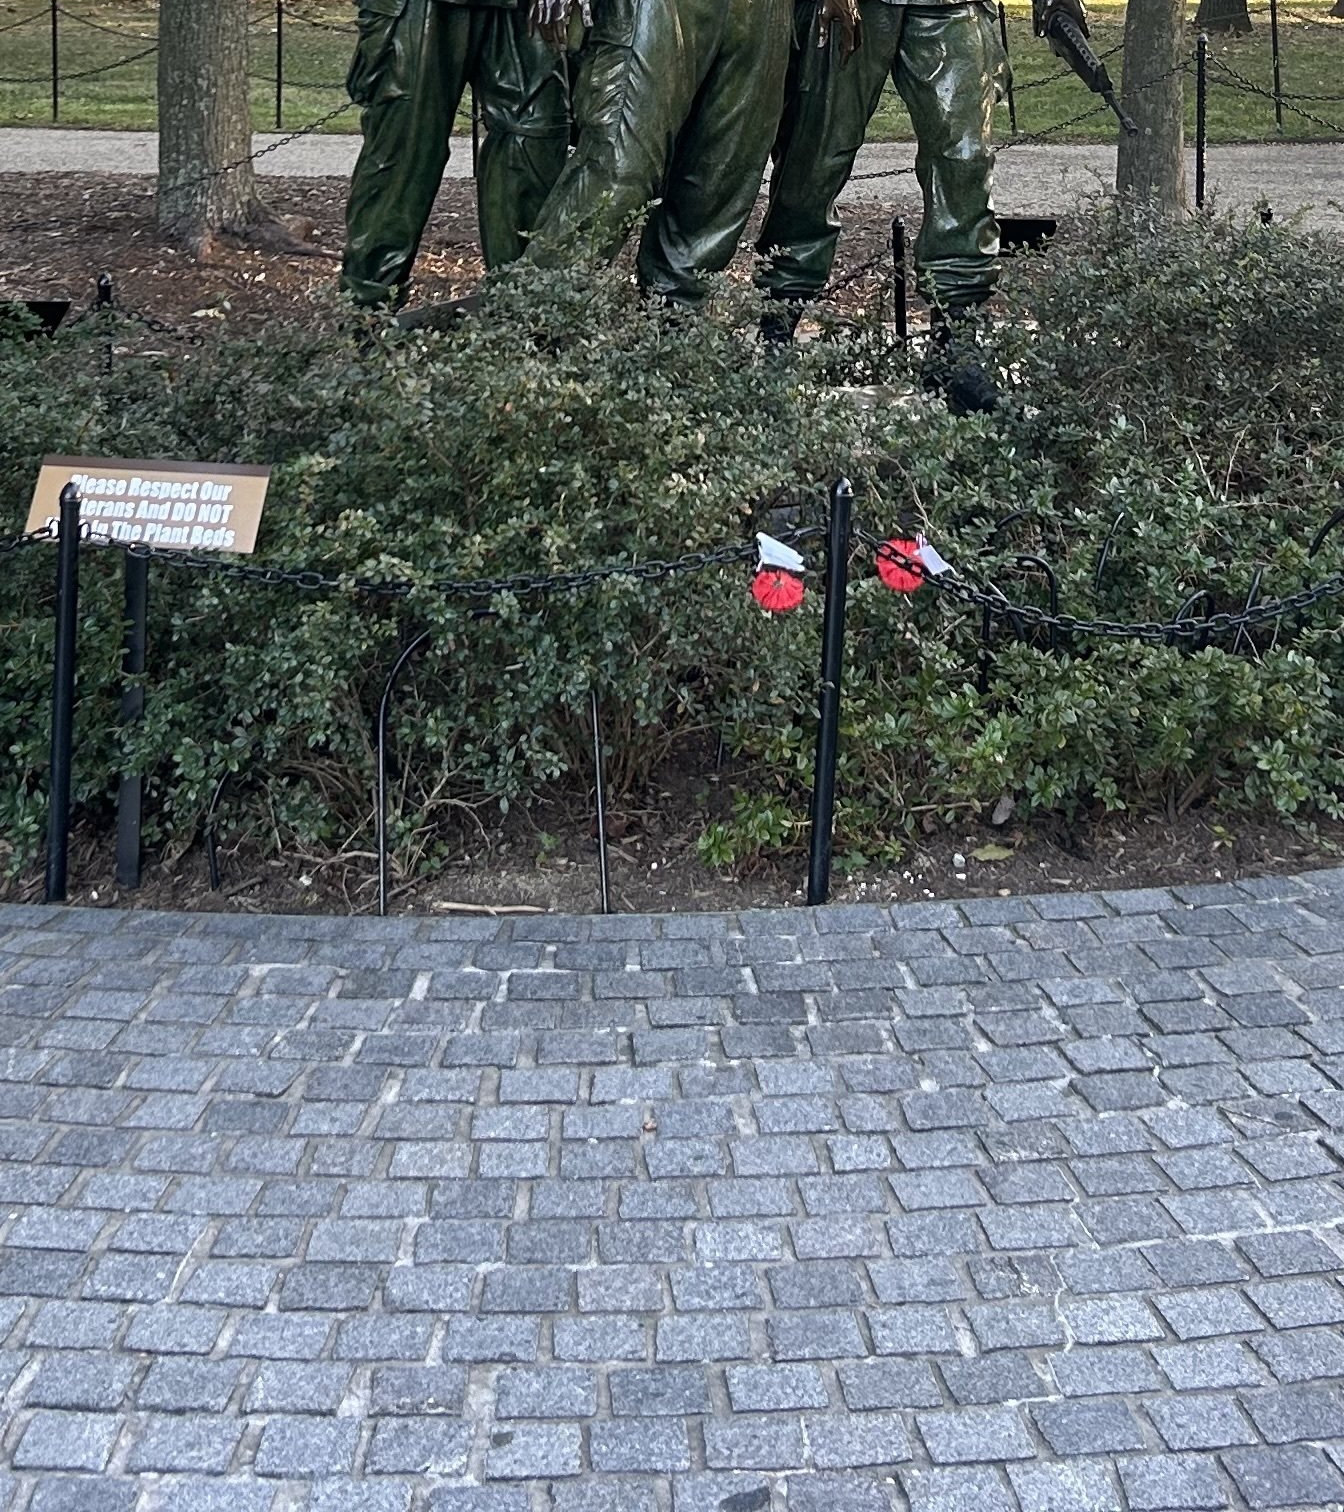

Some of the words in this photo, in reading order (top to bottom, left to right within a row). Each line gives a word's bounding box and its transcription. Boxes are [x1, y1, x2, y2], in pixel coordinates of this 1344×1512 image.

[127, 477, 199, 499] Respect
[200, 481, 232, 501] Our
[135, 500, 171, 520] And
[171, 502, 197, 522] DO
[197, 503, 233, 524] NOT
[111, 520, 142, 541] The
[142, 522, 189, 544] Plant
[190, 525, 235, 547] Beds
